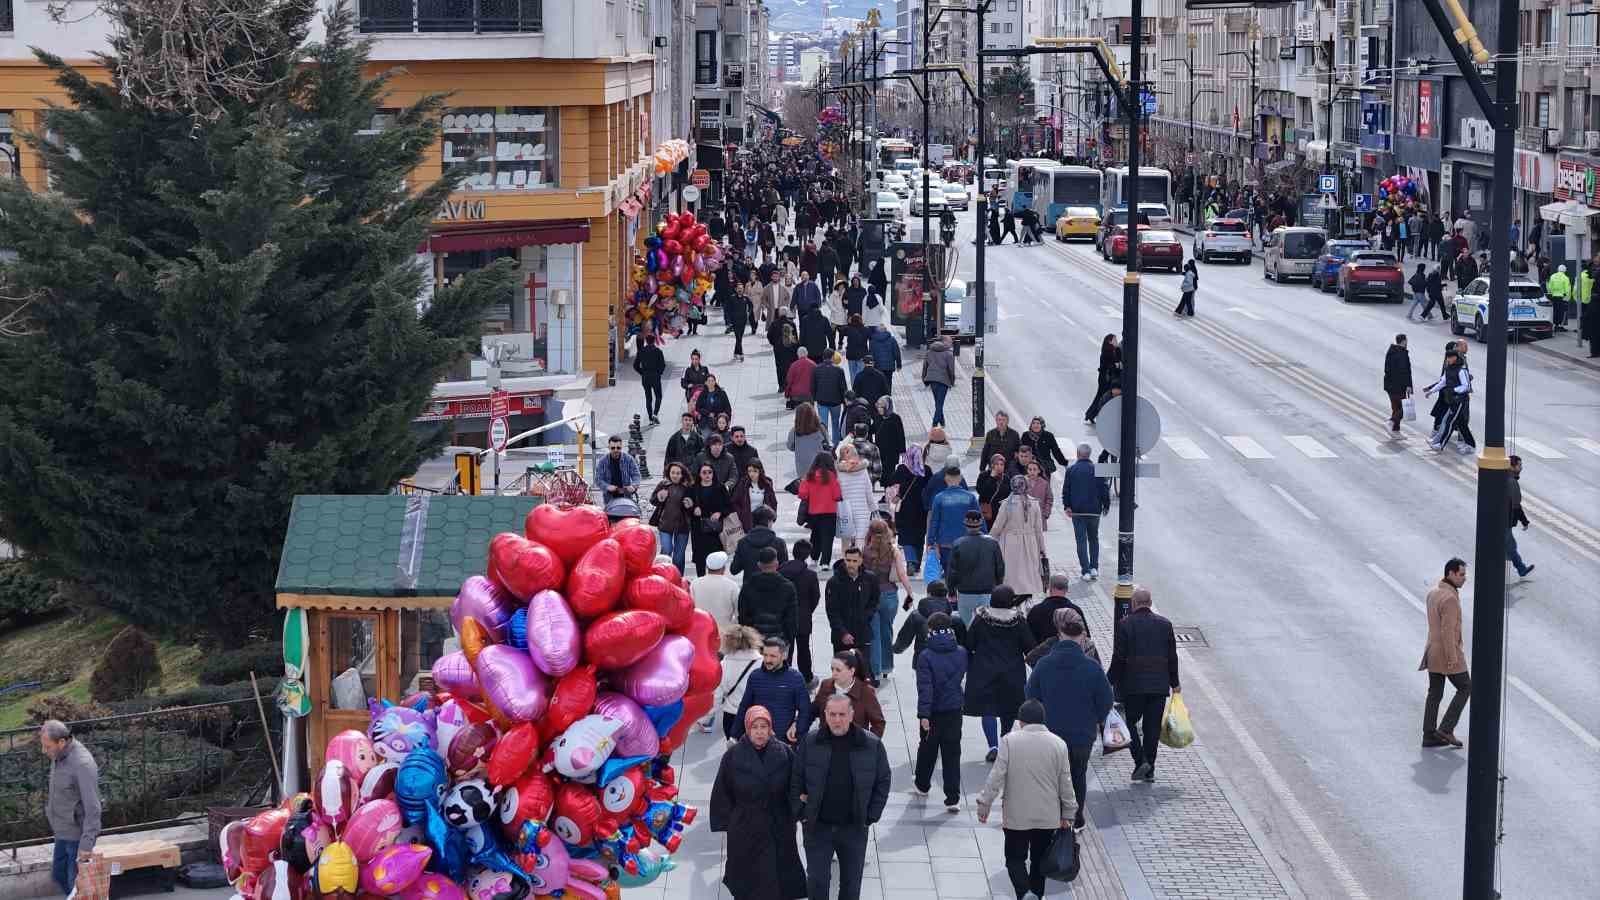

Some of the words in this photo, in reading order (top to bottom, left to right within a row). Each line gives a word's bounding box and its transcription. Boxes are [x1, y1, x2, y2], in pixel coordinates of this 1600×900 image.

[1324, 178, 1332, 188] D
[1355, 195, 1365, 207] P
[437, 199, 487, 220] AVM
